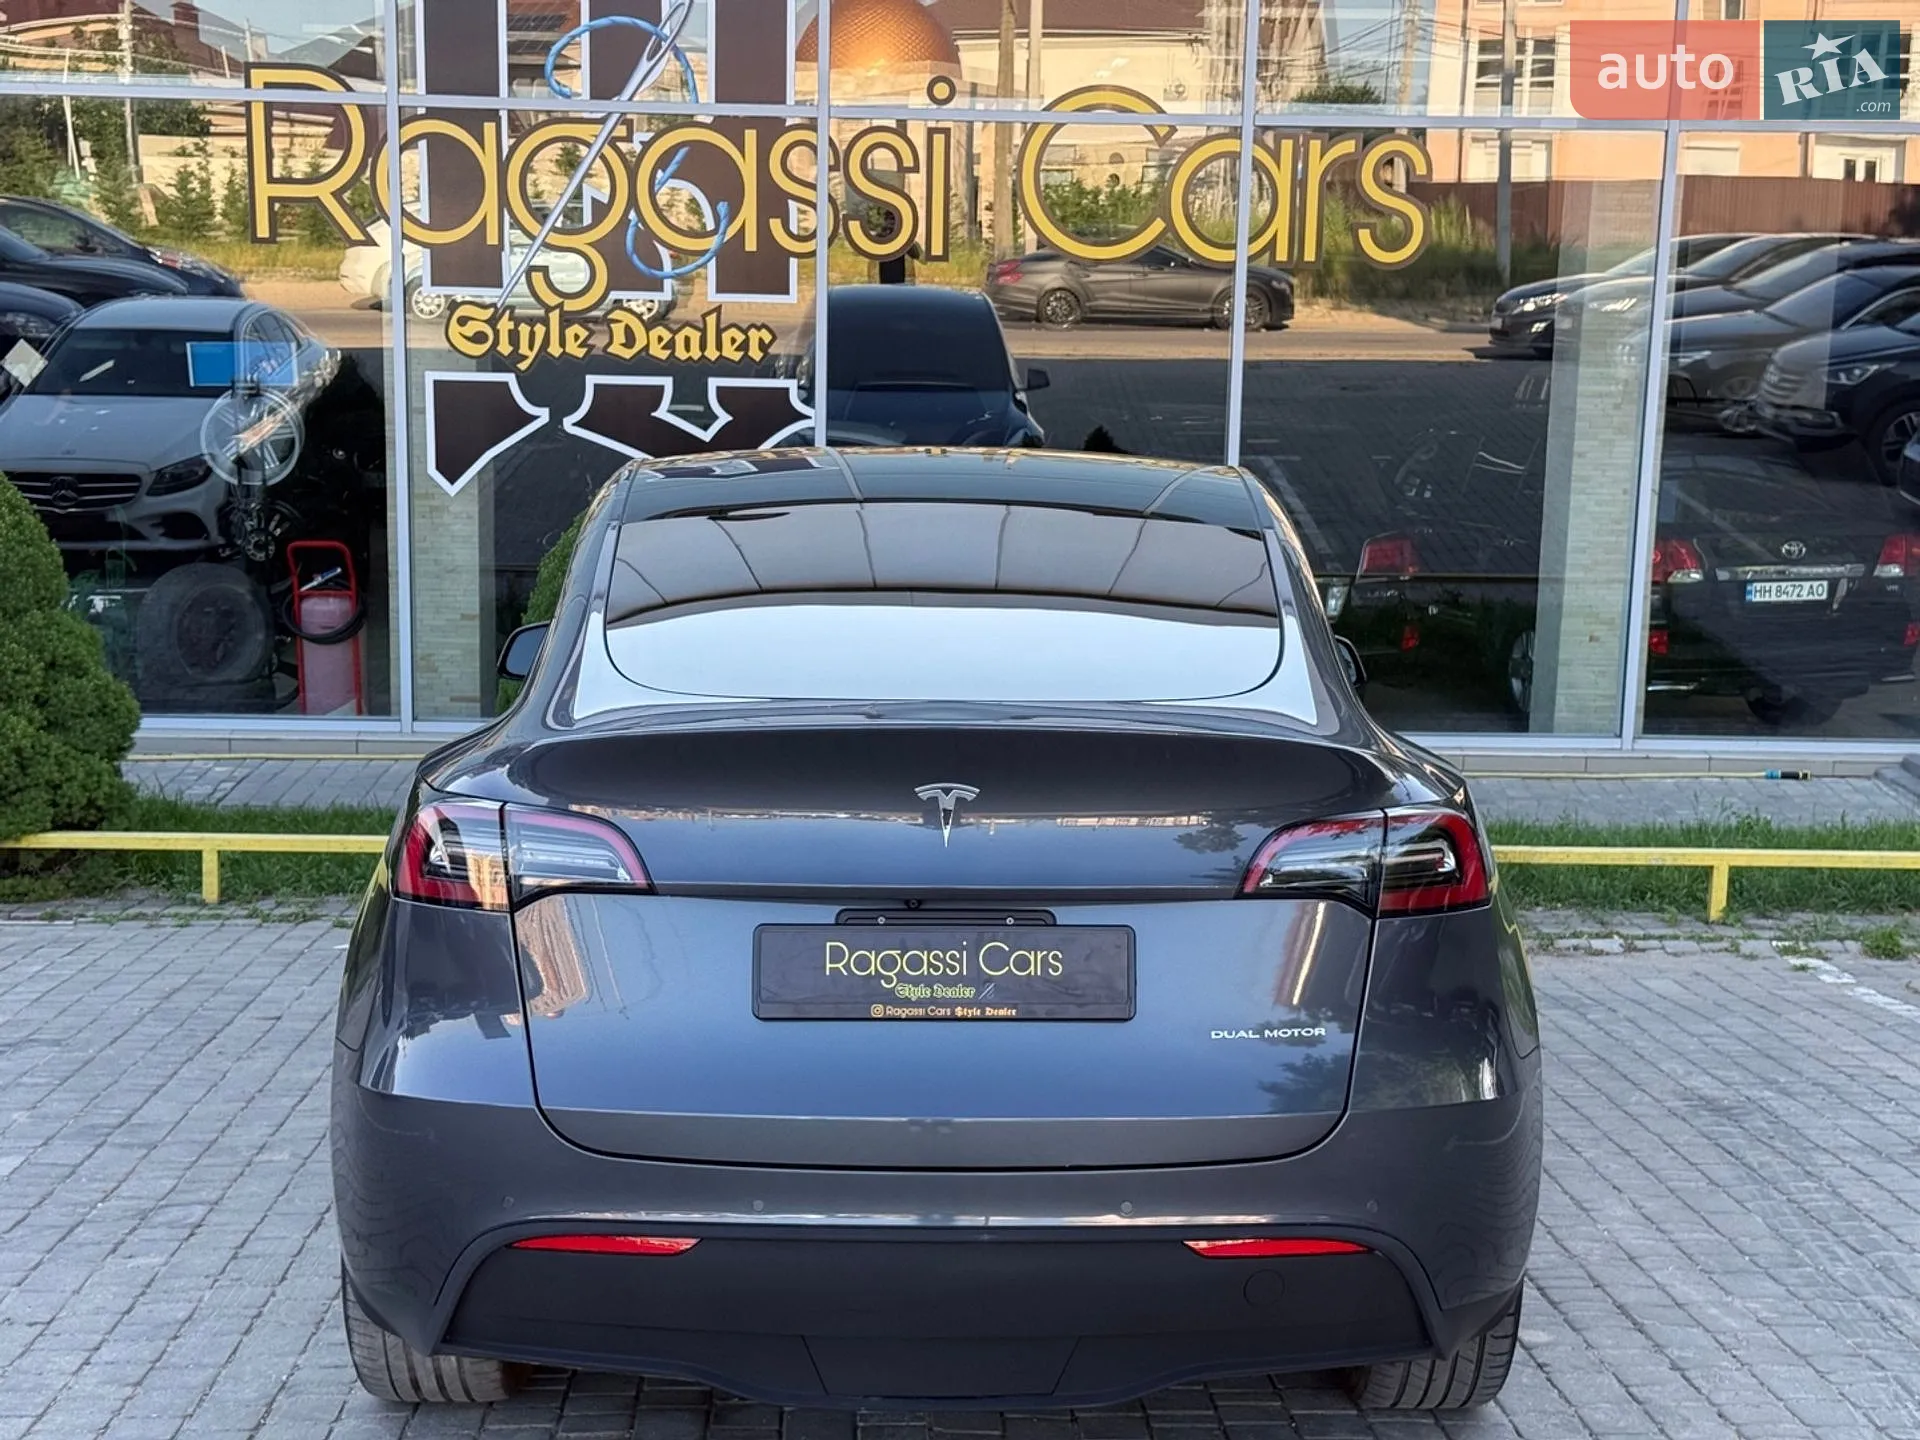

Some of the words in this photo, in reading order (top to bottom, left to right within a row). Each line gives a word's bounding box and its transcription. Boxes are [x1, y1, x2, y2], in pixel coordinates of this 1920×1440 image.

[245, 62, 958, 313] Ragassi
[1018, 84, 1433, 269] Cars
[445, 300, 594, 373] Style
[606, 305, 777, 367] Dealer
[1754, 584, 1772, 598] HH
[1775, 584, 1804, 598] 8472
[1807, 583, 1825, 597] AO
[825, 941, 968, 988] Ragassi
[979, 941, 1063, 977] Cars
[895, 982, 932, 1001] Style
[933, 982, 976, 999] Dealer
[886, 1006, 925, 1018] Ragassi
[927, 1006, 951, 1016] Cars
[955, 1005, 981, 1017] Style
[985, 1006, 1017, 1016] Dealer
[1211, 1030, 1260, 1039] DUAL
[1264, 1027, 1326, 1038] MOTOR
